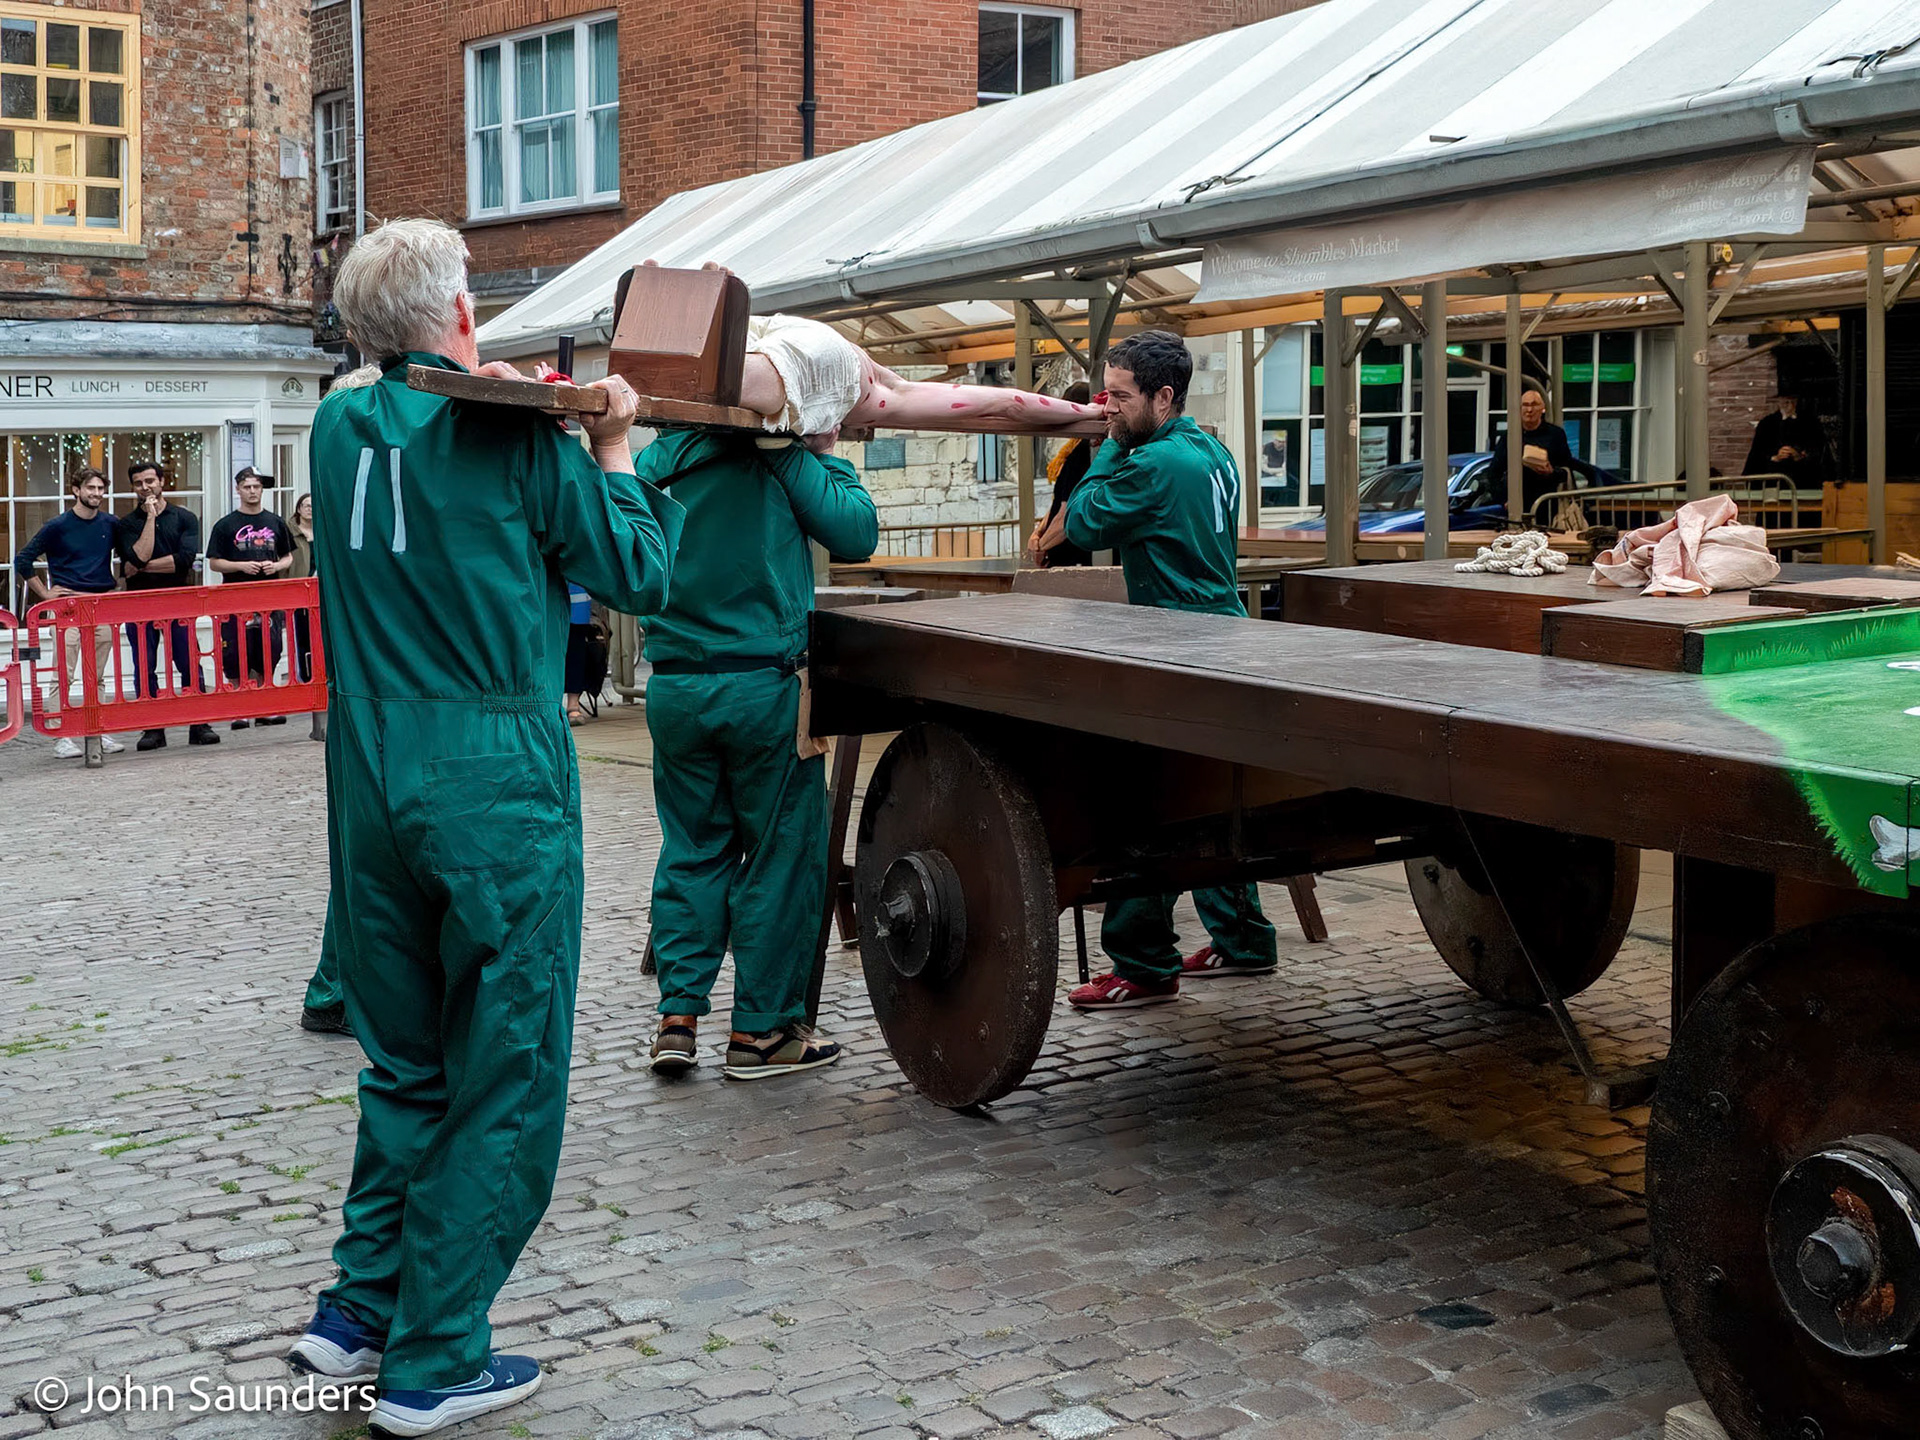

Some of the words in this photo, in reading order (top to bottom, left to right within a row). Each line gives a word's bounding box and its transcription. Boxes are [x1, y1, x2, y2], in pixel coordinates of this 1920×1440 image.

[1211, 253, 1261, 276] Welcome
[1280, 242, 1346, 267] Shambles
[1349, 234, 1400, 258] Market
[71, 380, 120, 392] LUNCH
[145, 380, 208, 393] DESSERT
